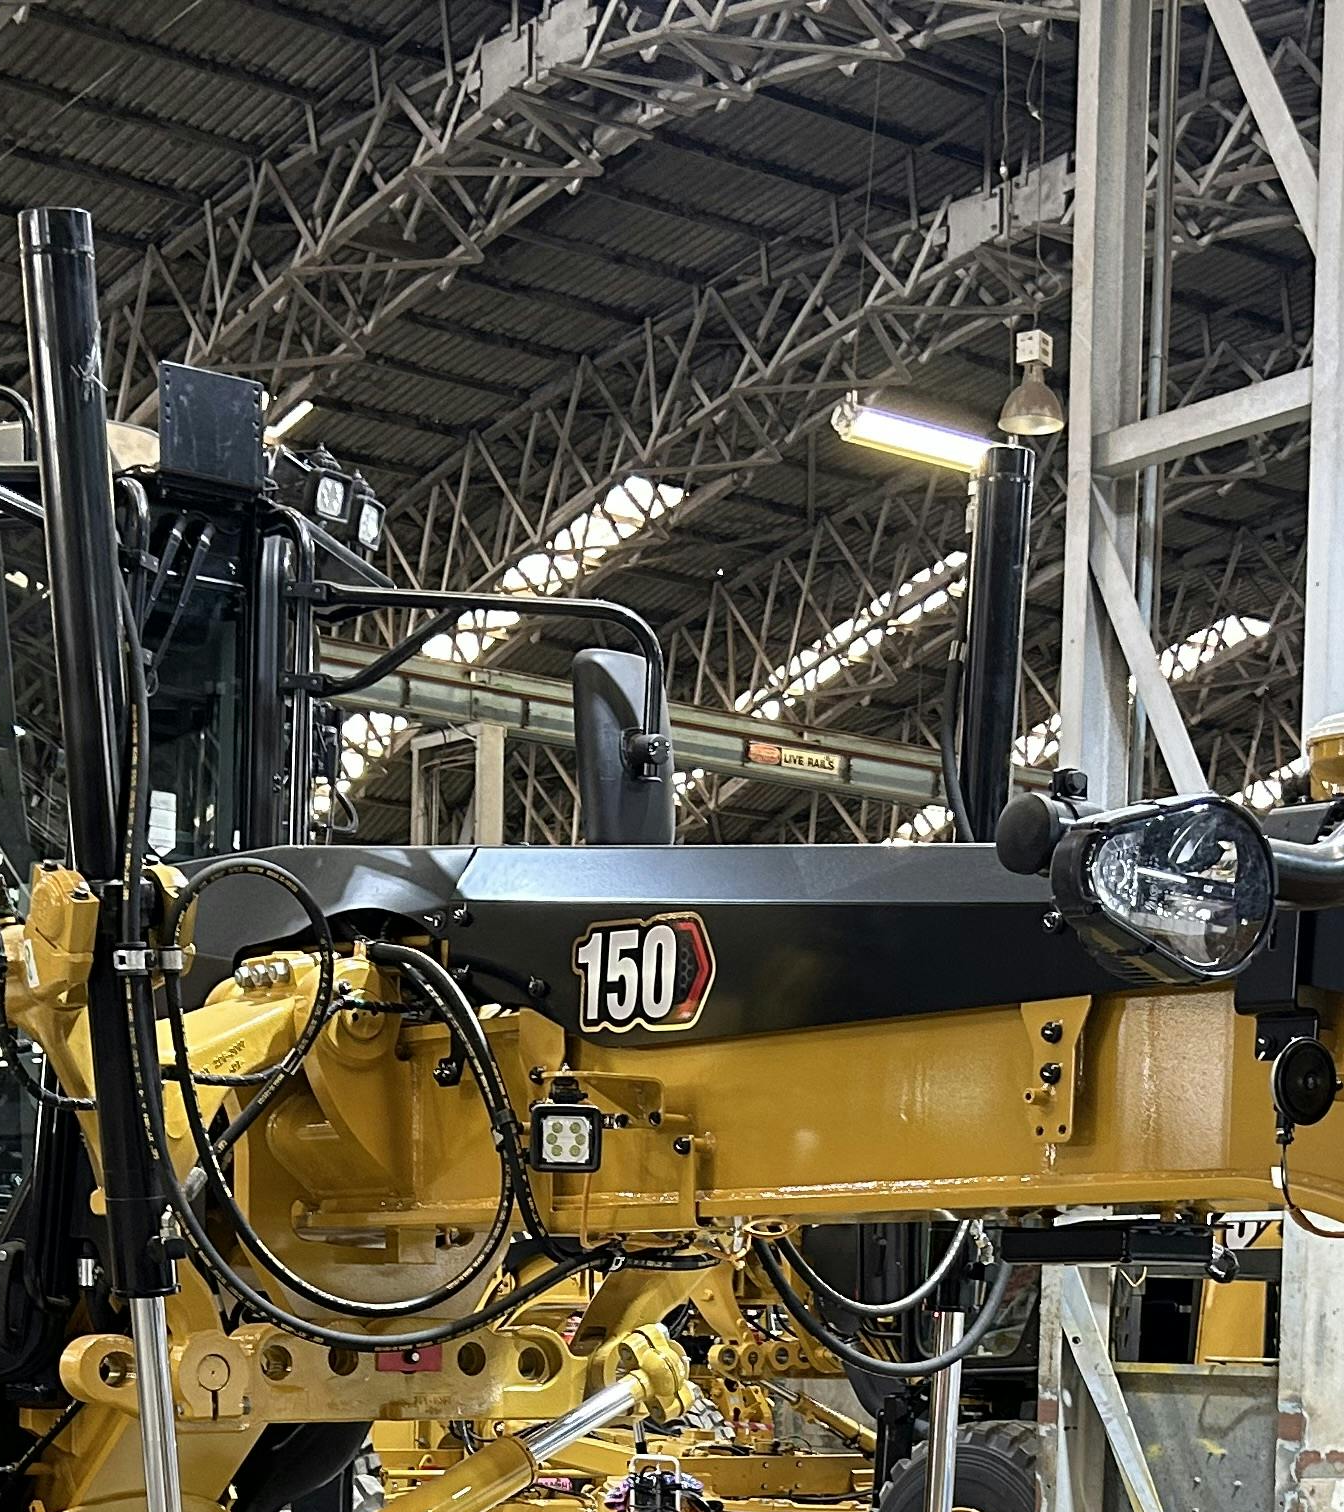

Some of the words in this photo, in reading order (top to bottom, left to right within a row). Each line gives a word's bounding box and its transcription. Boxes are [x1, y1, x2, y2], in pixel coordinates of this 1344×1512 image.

[783, 753, 804, 767] LIVE
[807, 756, 835, 771] RAILS
[578, 924, 677, 1020] 150
